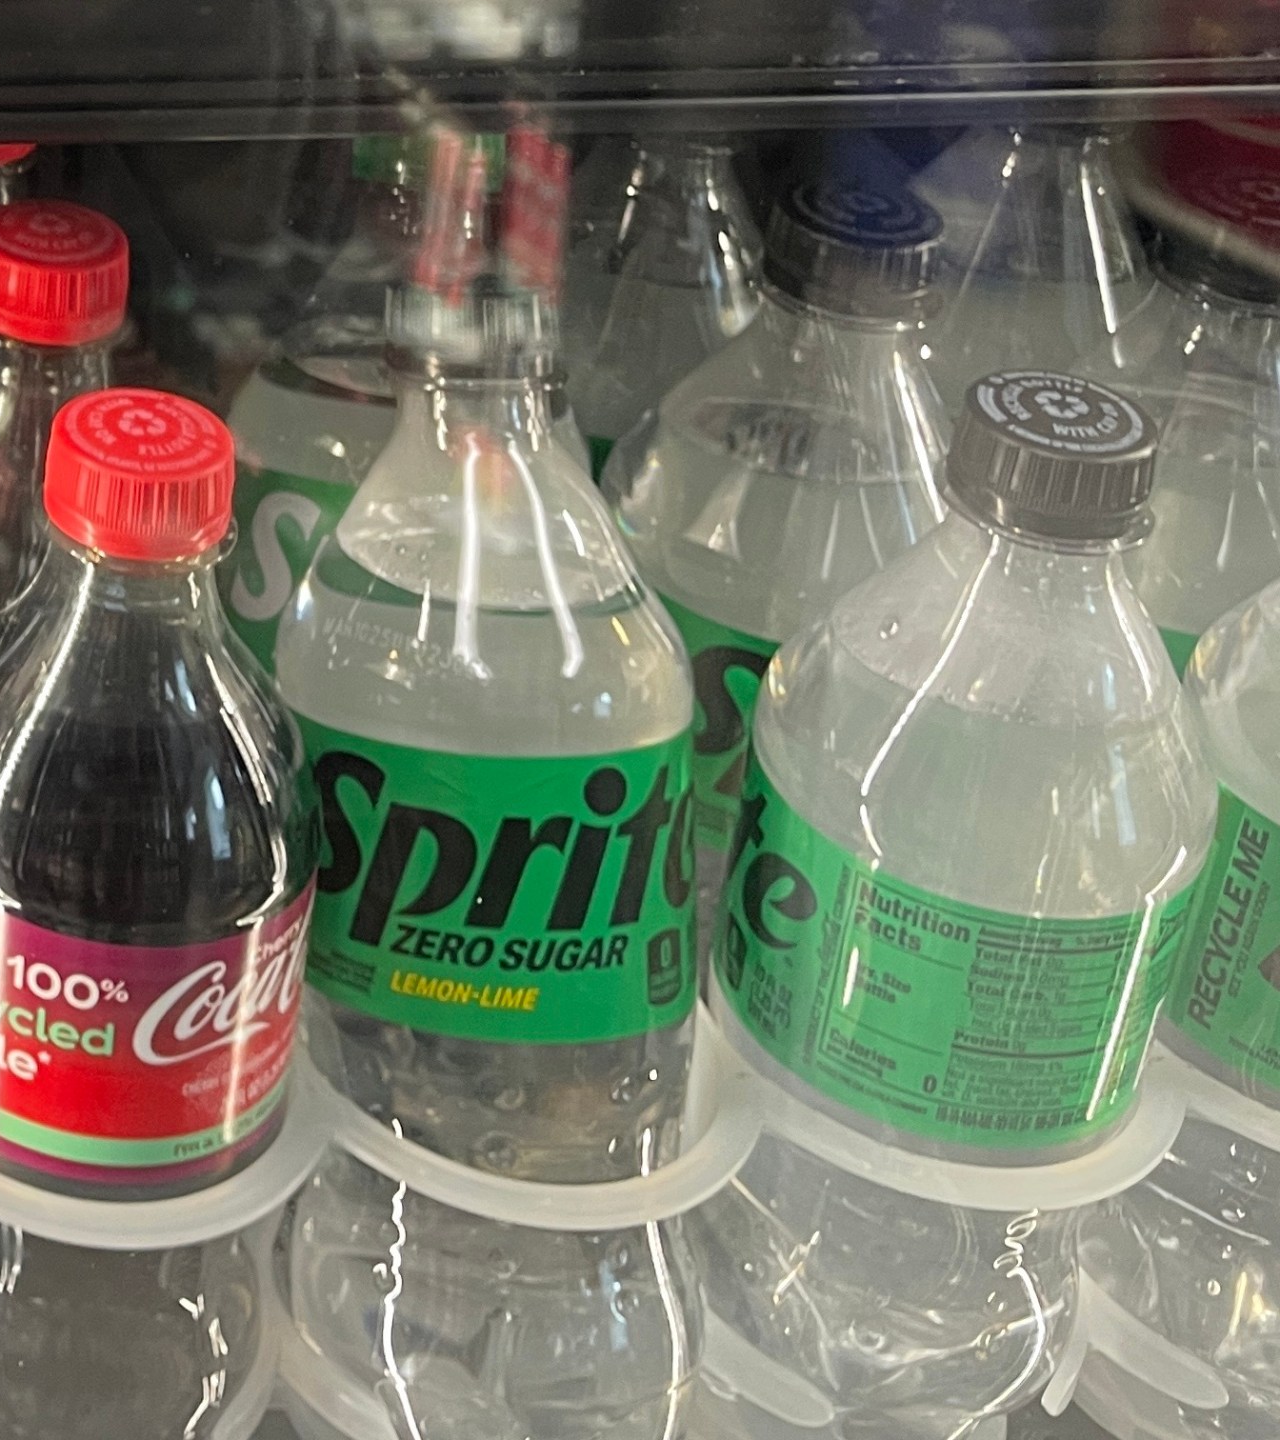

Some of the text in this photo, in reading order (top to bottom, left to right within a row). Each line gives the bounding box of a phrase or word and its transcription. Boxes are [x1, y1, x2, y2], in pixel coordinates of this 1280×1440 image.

[855, 909, 922, 952] Facts
[859, 881, 971, 944] Nutrition
[1188, 818, 1270, 1030] RECYCLE ME
[389, 922, 630, 972] ZERO SUGAR
[7, 953, 130, 1010] 100%
[390, 969, 541, 1012] LEMON-LIME
[923, 1074, 937, 1094] 0
